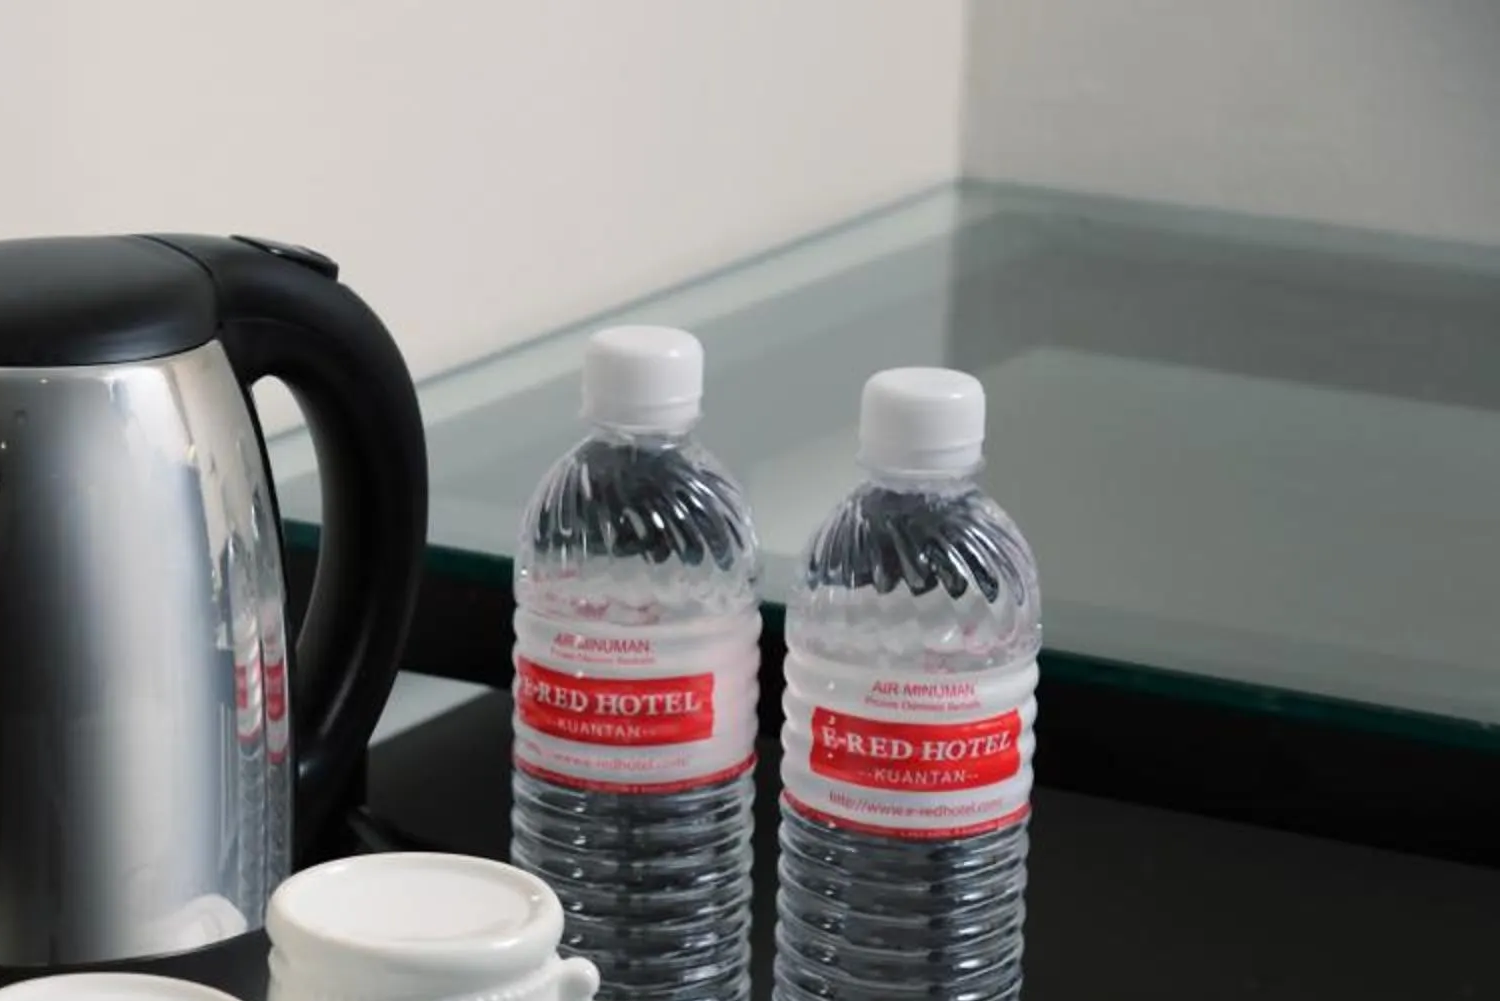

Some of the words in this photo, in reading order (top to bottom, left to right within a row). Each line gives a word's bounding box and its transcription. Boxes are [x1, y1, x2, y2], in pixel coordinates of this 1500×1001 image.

[872, 681, 899, 694] AIR
[595, 690, 701, 717] HOTEL
[920, 729, 1012, 763] HOTEL
